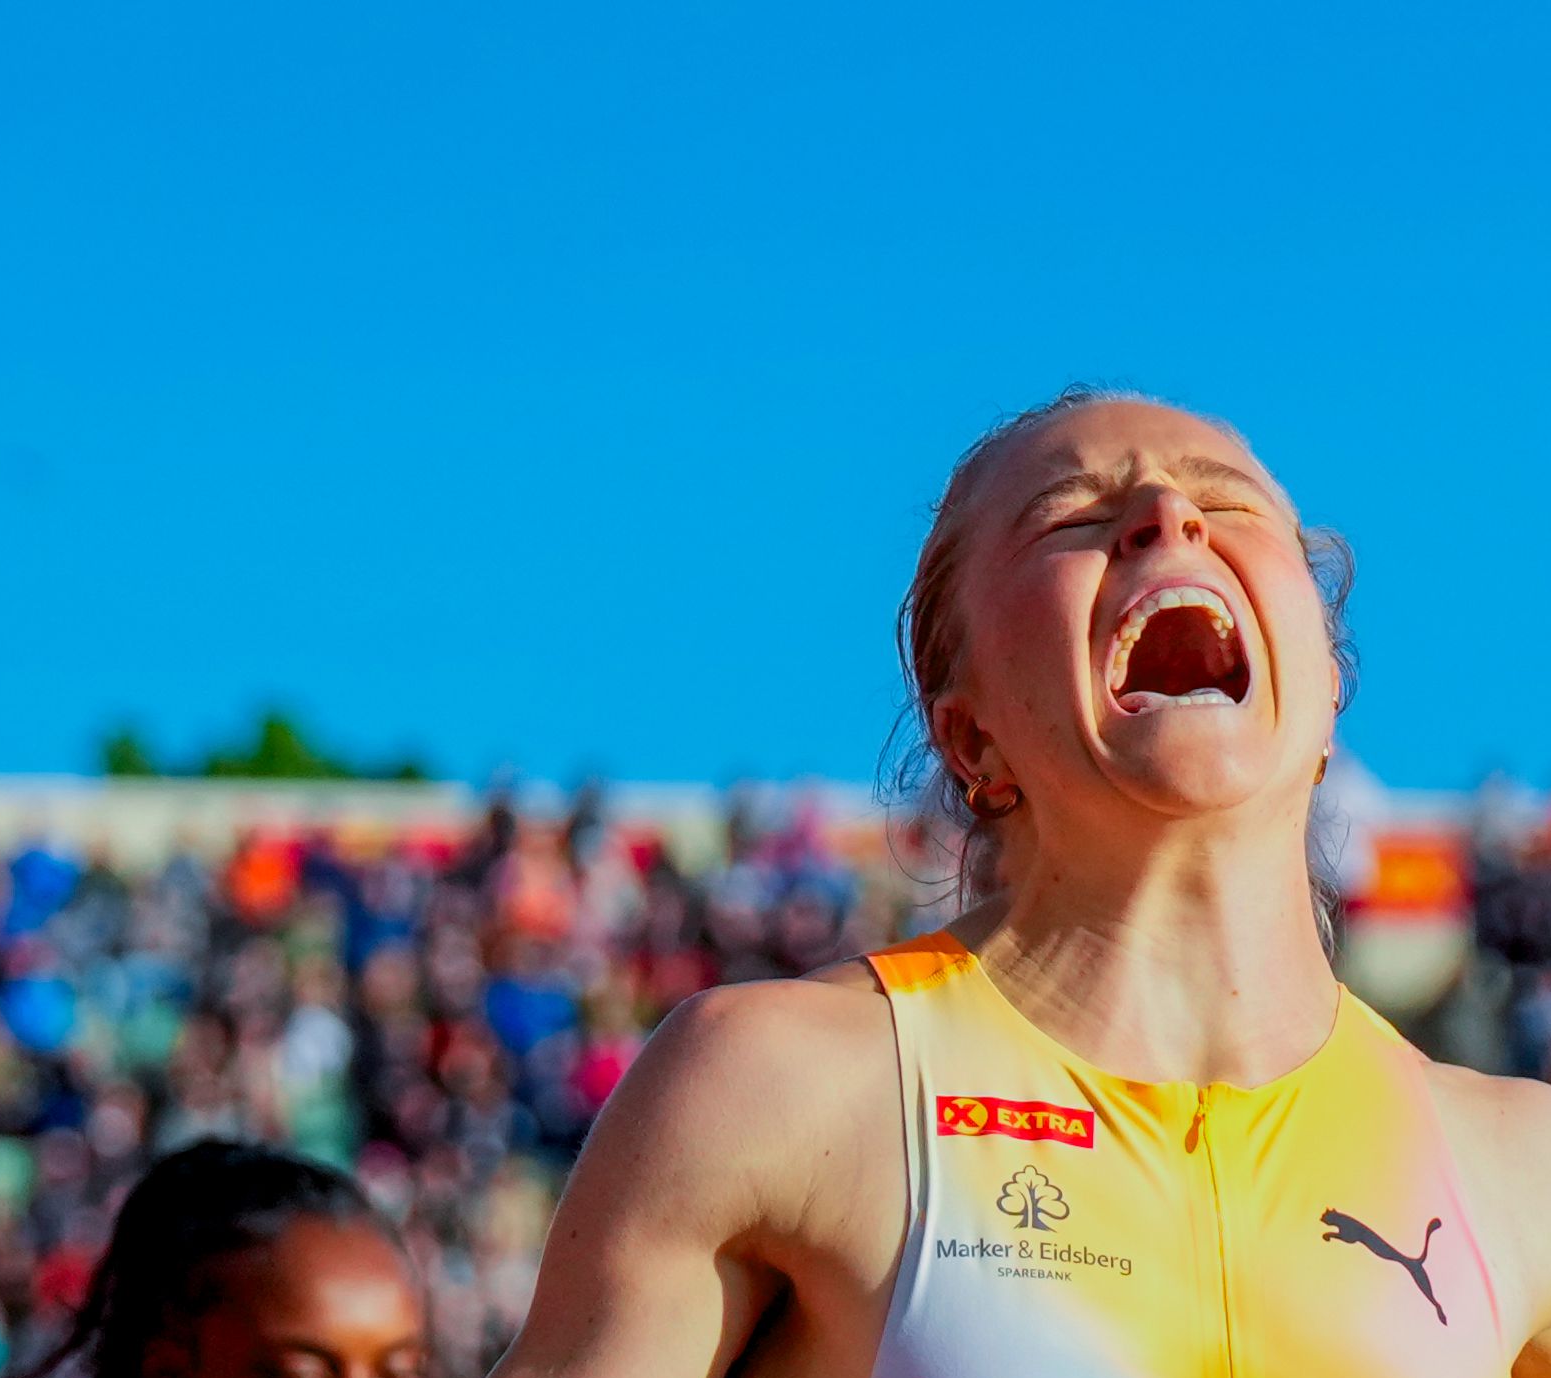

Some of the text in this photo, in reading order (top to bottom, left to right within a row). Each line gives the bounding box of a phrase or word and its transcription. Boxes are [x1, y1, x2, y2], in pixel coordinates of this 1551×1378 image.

[997, 1108, 1087, 1139] EXTRA
[936, 1238, 1133, 1276] Marker & Eidsberg
[997, 1267, 1073, 1282] SPAREBANK
